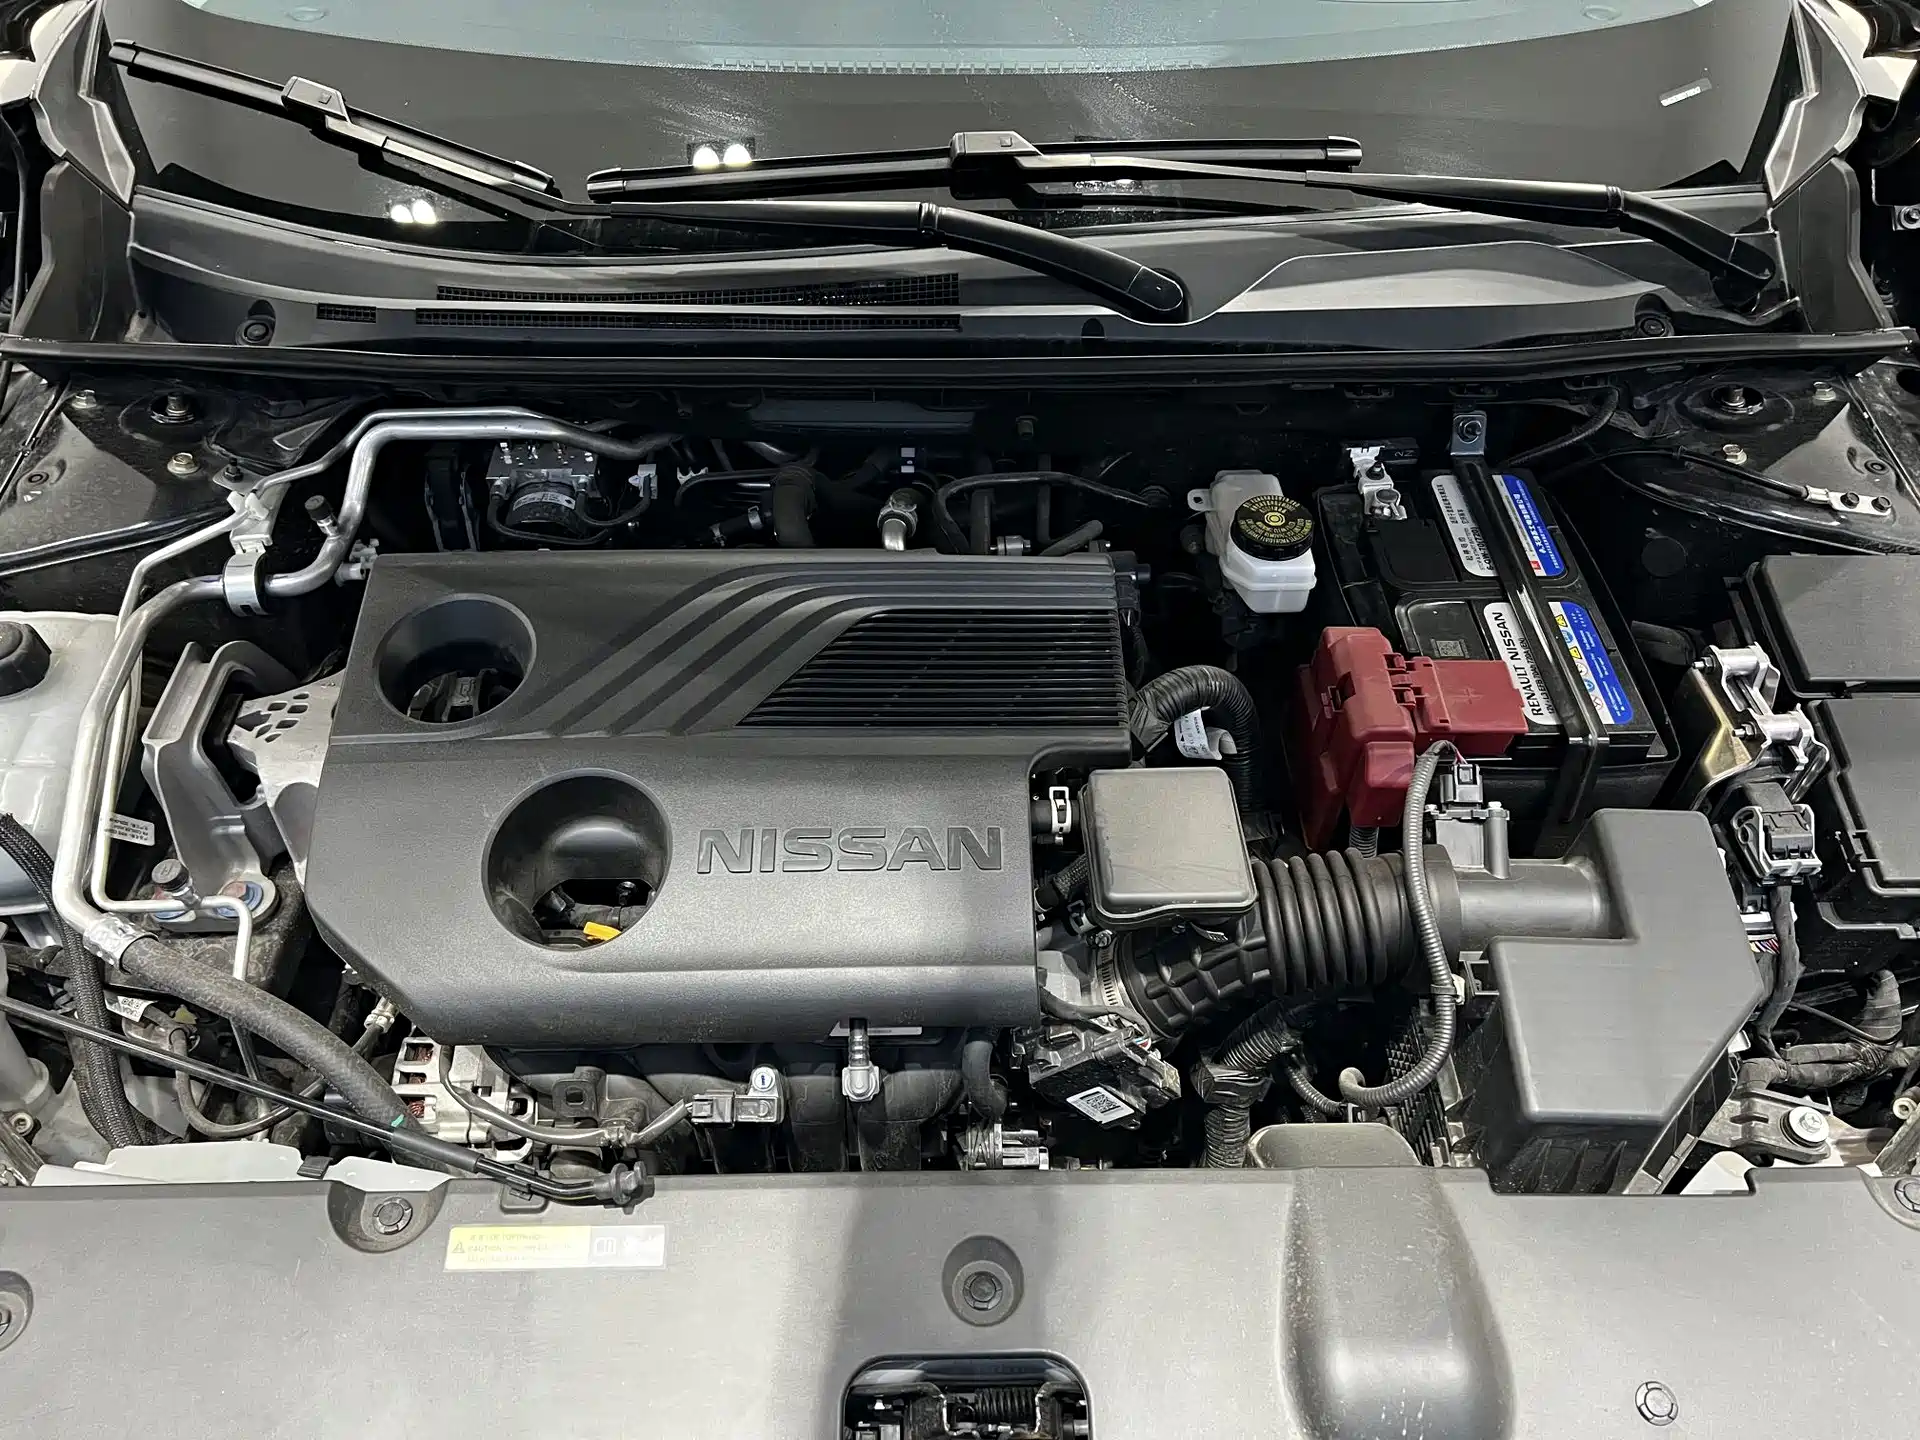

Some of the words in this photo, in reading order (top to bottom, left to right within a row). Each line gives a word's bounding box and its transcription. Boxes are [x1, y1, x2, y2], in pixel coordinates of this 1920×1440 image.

[1492, 612, 1520, 660] NISSAN
[1513, 665, 1543, 715] RENAULT
[697, 827, 1002, 873] NISSAN
